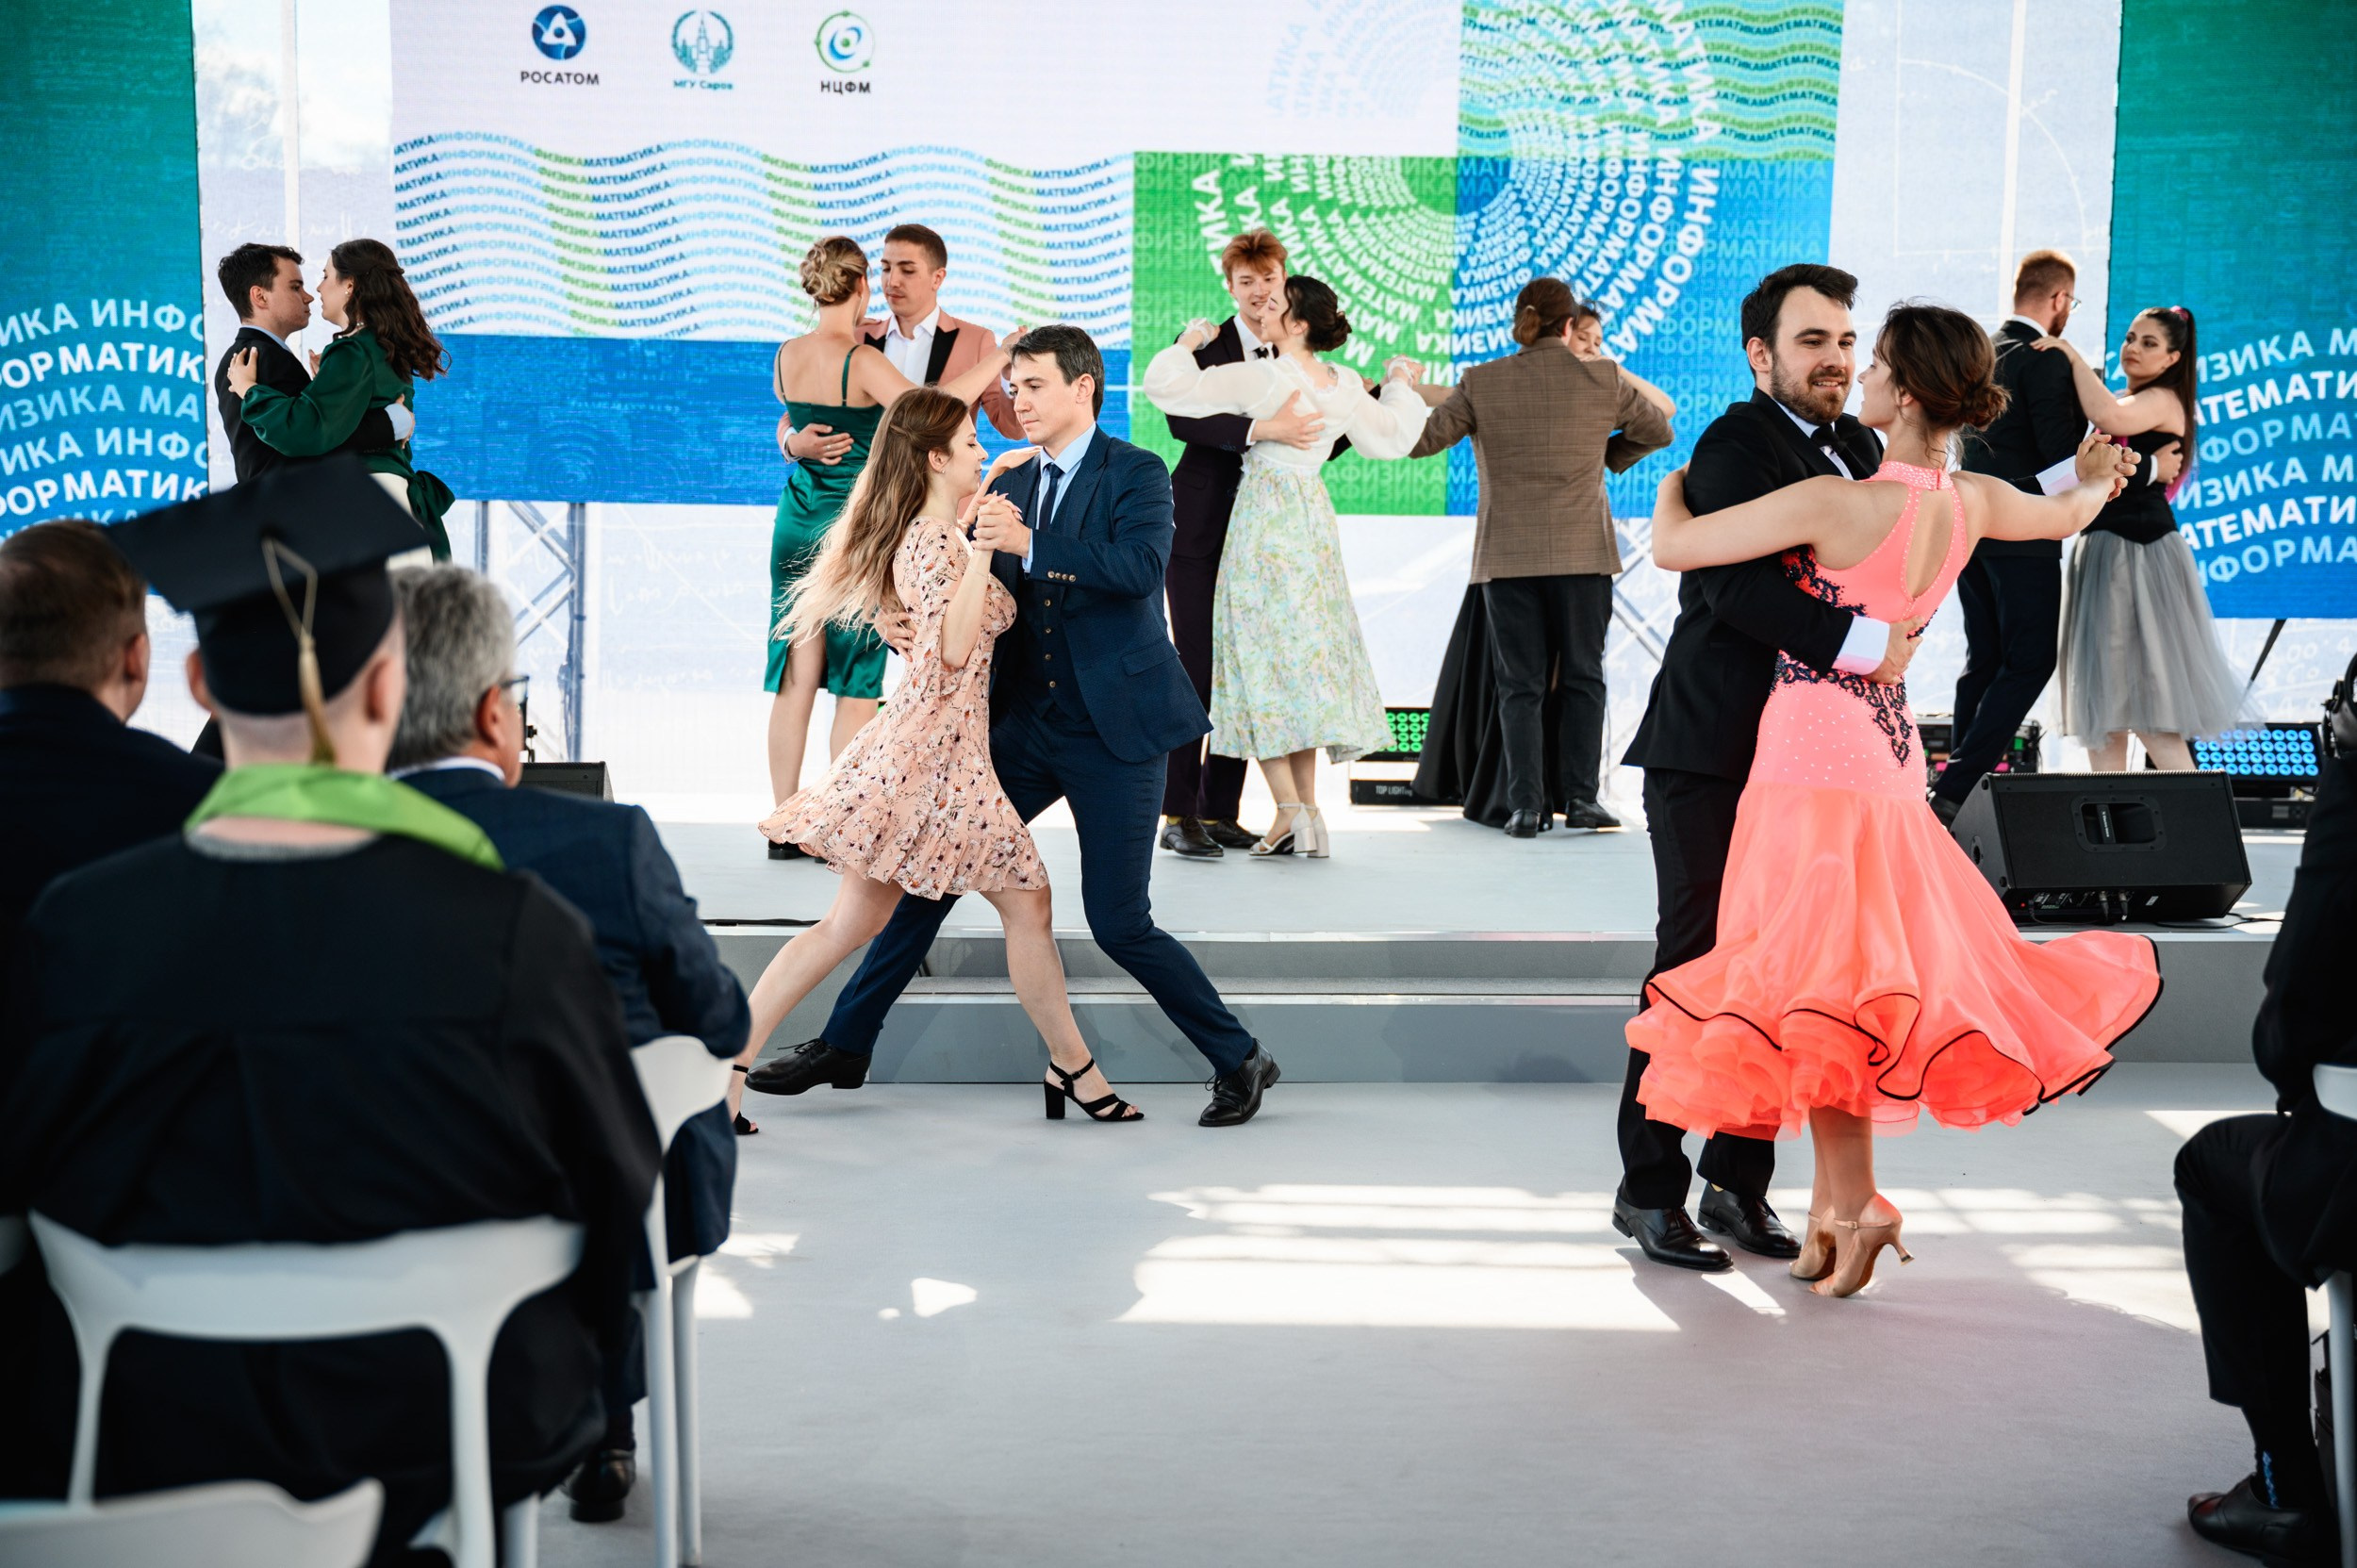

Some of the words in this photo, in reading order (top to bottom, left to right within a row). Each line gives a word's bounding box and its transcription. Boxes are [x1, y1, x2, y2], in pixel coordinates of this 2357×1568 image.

[520, 71, 600, 86] РОСАТОМ
[673, 79, 696, 90] МГУ
[701, 79, 733, 91] Саров
[820, 80, 871, 95] НЦФМ
[585, 142, 664, 167] МАТЕМАТИКА
[810, 150, 888, 174] МАТЕМАТИКА
[1033, 157, 1111, 179] МАТЕМАТИКА
[588, 161, 667, 186] МАТЕМАТИКА
[814, 169, 891, 192] МАТЕМАТИКА
[1037, 174, 1113, 197] МАТЕМАТИКА
[592, 179, 670, 204] МАТЕМАТИКА
[817, 186, 895, 210] МАТЕМАТИКА
[1040, 192, 1116, 215] МАТЕМАТИКА
[596, 197, 674, 222] МАТЕМАТИКА
[821, 204, 898, 227] МАТЕМАТИКА
[1043, 210, 1119, 233] МАТЕМАТИКА
[600, 215, 678, 239] МАТЕМАТИКА
[1047, 228, 1122, 251] МАТЕМАТИКА
[604, 233, 682, 257] МАТЕМАТИКА
[1050, 246, 1126, 268] МАТЕМАТИКА
[607, 251, 685, 275] МАТЕМАТИКА
[1053, 263, 1129, 286] МАТЕМАТИКА
[1601, 167, 1720, 365] ИНФОРМА
[612, 268, 689, 292] МАТЕМАТИКА
[616, 286, 693, 310] МАТЕМАТИКА
[618, 304, 697, 328] МАТЕМАТИКА
[0, 342, 206, 389] ОРМАТИК
[2195, 371, 2357, 427] ТЕМАТИ
[2200, 412, 2357, 463] ФОРМА
[2176, 456, 2308, 511] ИЗИКА
[2322, 454, 2357, 483] М
[2179, 495, 2357, 551] АТЕМАТИ
[2198, 536, 2357, 587] ФОРМА
[1376, 785, 1388, 796] TOP
